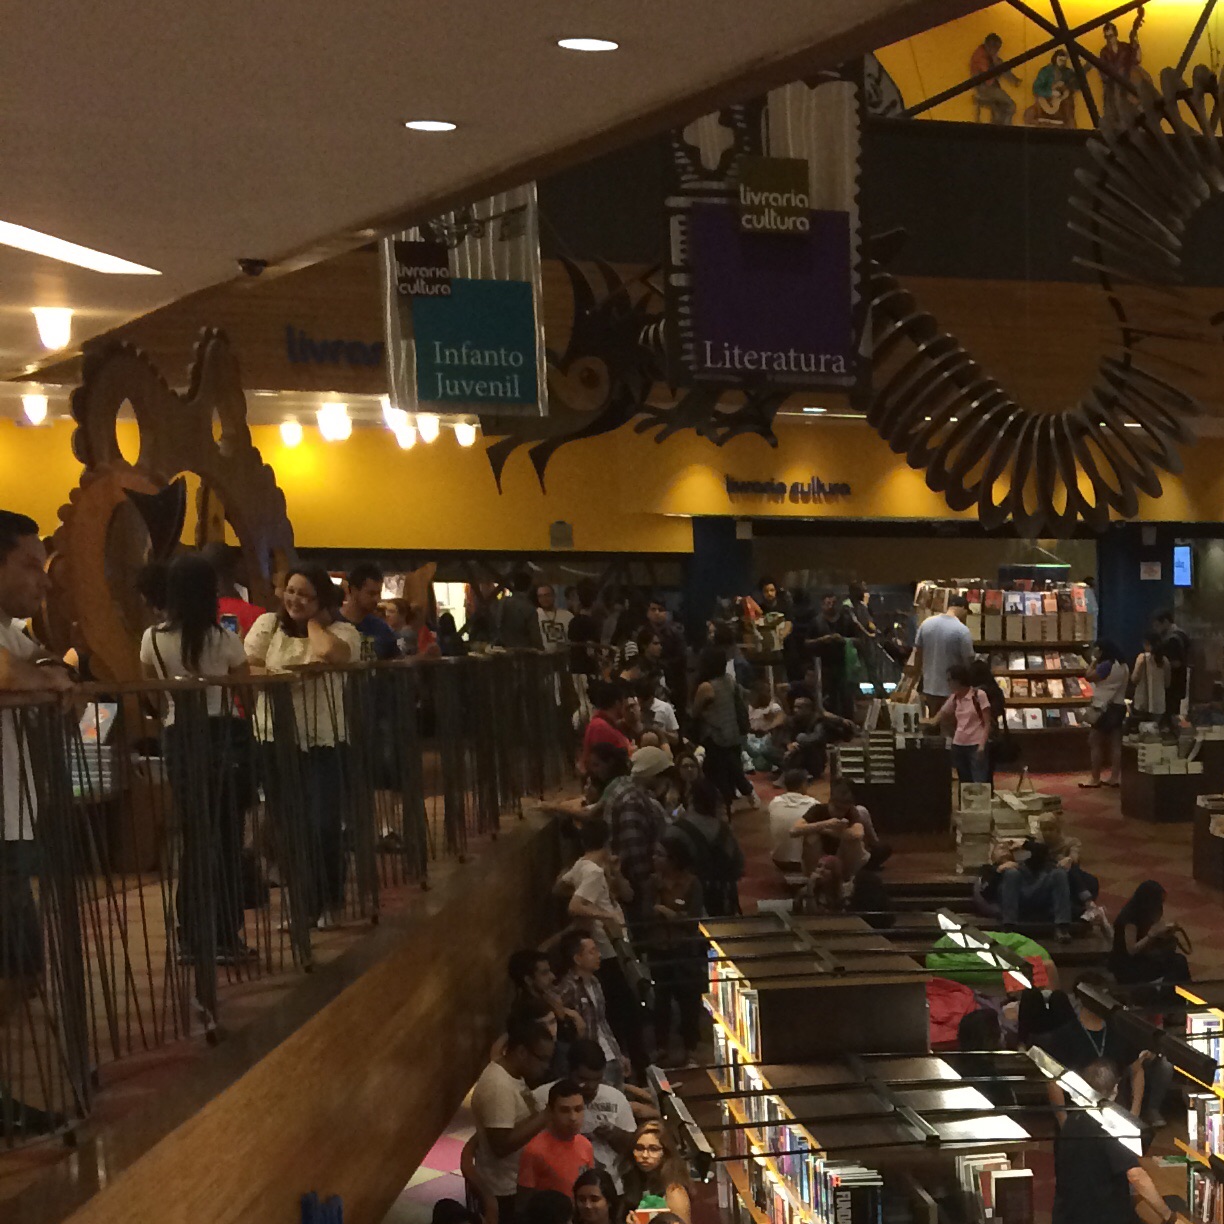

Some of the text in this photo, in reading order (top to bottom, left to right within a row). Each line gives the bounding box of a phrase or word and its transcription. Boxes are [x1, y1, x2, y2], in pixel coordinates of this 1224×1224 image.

[739, 183, 809, 208] livraria
[741, 208, 810, 231] cultura
[395, 260, 450, 279] livraria
[399, 278, 452, 296] cultura
[433, 339, 525, 368] Infanto
[703, 340, 847, 374] Literatura
[436, 371, 522, 400] Juvenil
